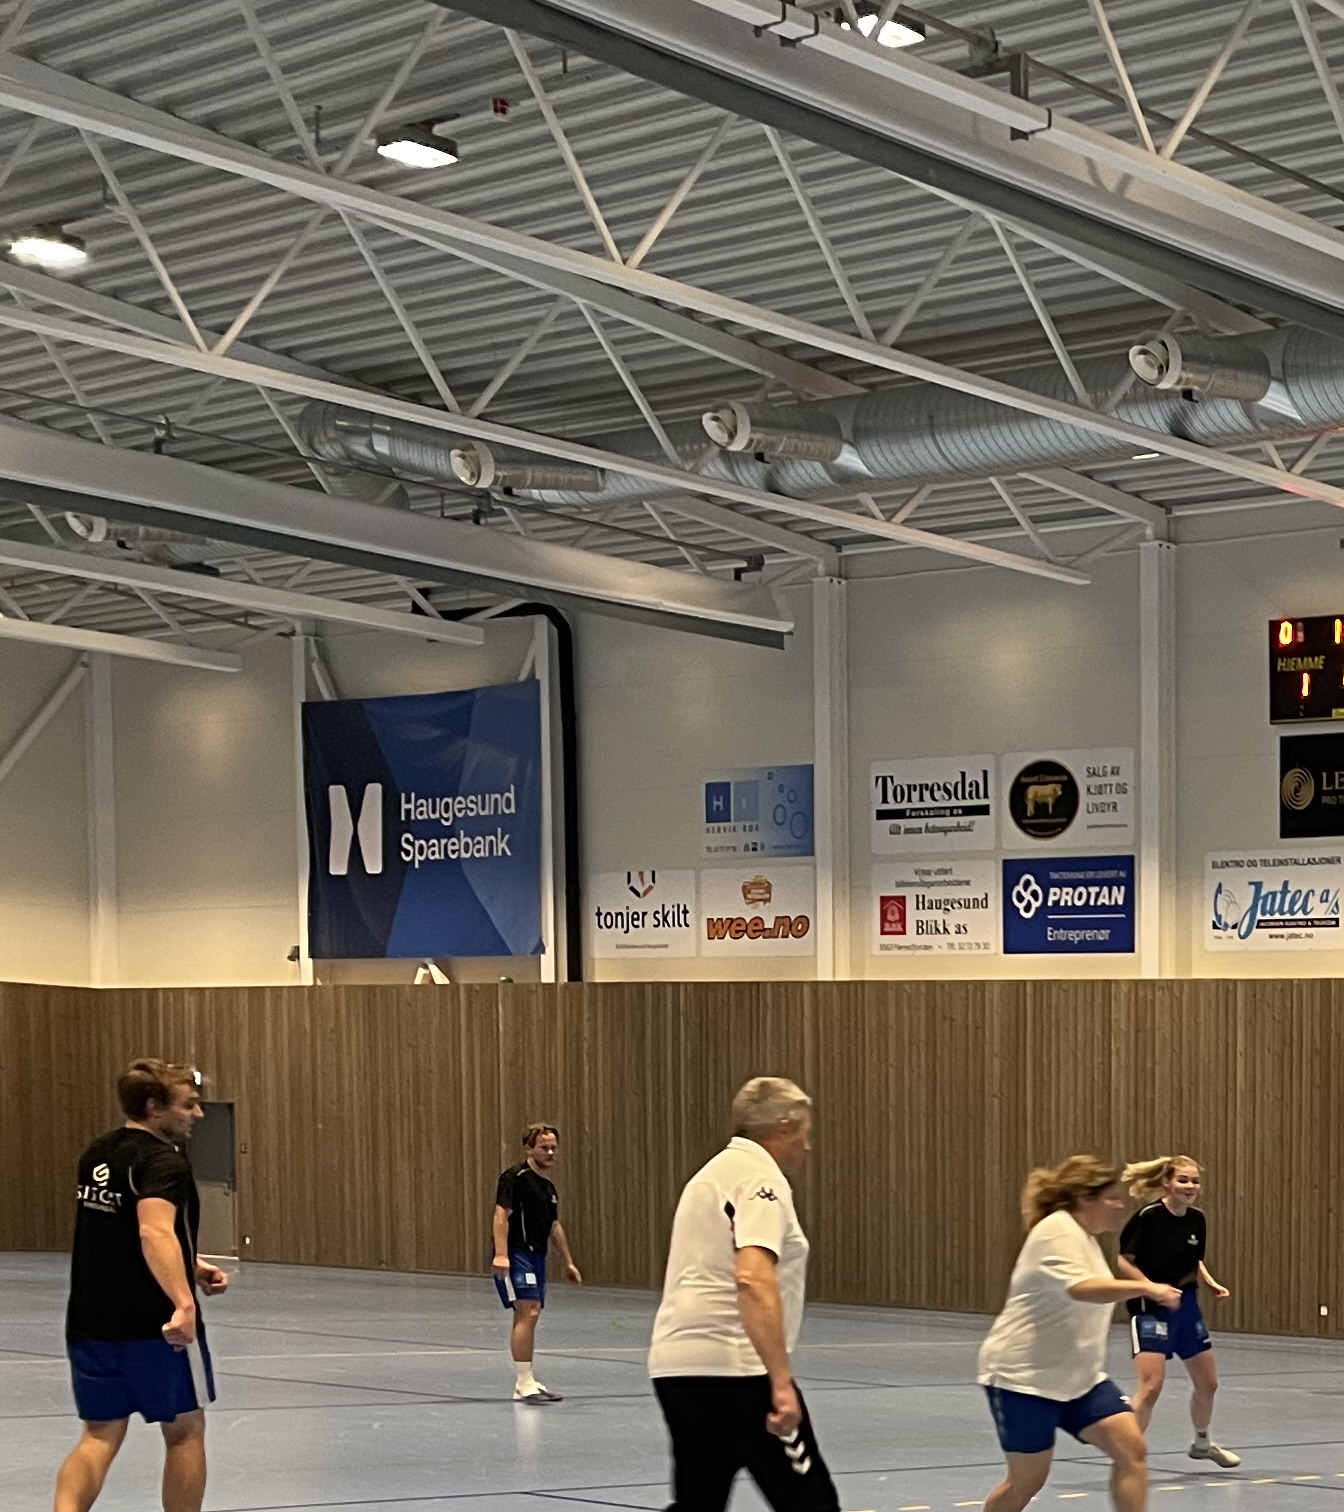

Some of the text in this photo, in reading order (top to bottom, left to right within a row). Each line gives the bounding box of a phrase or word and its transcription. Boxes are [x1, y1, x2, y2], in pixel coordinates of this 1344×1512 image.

[1277, 656, 1326, 672] HJEMME
[1086, 766, 1108, 778] SALG
[875, 769, 990, 805] Torresdal
[401, 784, 516, 826] Haugesund
[400, 828, 512, 868] Sparebank
[915, 892, 989, 915] Haugesund
[1047, 885, 1125, 907] PROTAN
[595, 903, 690, 934] tonjer skilt
[1237, 880, 1316, 940] Jatec
[916, 919, 951, 935] Blikk
[954, 923, 968, 935] as
[1047, 926, 1111, 944] Entreprenør
